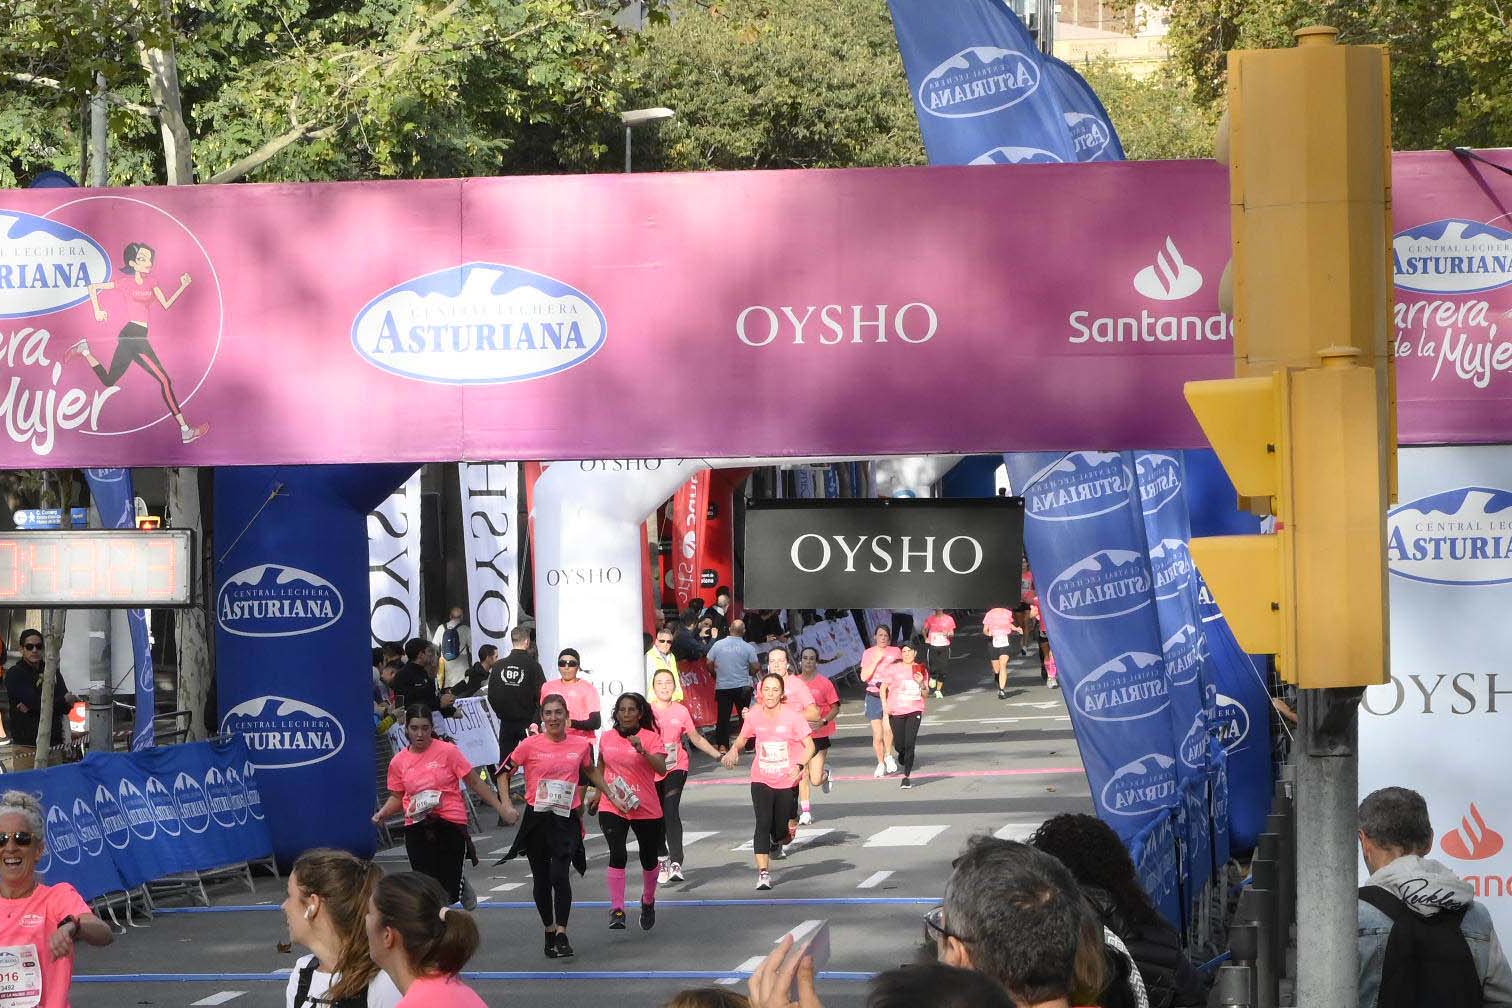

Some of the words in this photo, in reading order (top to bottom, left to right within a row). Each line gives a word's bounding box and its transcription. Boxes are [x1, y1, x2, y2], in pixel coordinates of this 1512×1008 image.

[13, 245, 86, 257] LECHERA
[735, 303, 938, 347] OYSHO
[1394, 300, 1490, 329] arrera
[372, 311, 587, 354] ASTURIANA
[1418, 330, 1435, 357] la
[1431, 324, 1512, 388] Muje
[1416, 522, 1481, 532] CENTRAL
[790, 534, 983, 574] OYSHO
[547, 567, 621, 587] OYSHO
[233, 589, 277, 597] CENTRAL
[281, 589, 330, 597] LECHERA
[222, 595, 334, 621] ASTURIANA
[507, 671, 519, 680] BP
[1363, 673, 1512, 716] OYSH
[235, 721, 277, 729] CENTRAL
[281, 720, 330, 728] LECHERA
[226, 726, 335, 750] TURIANA
